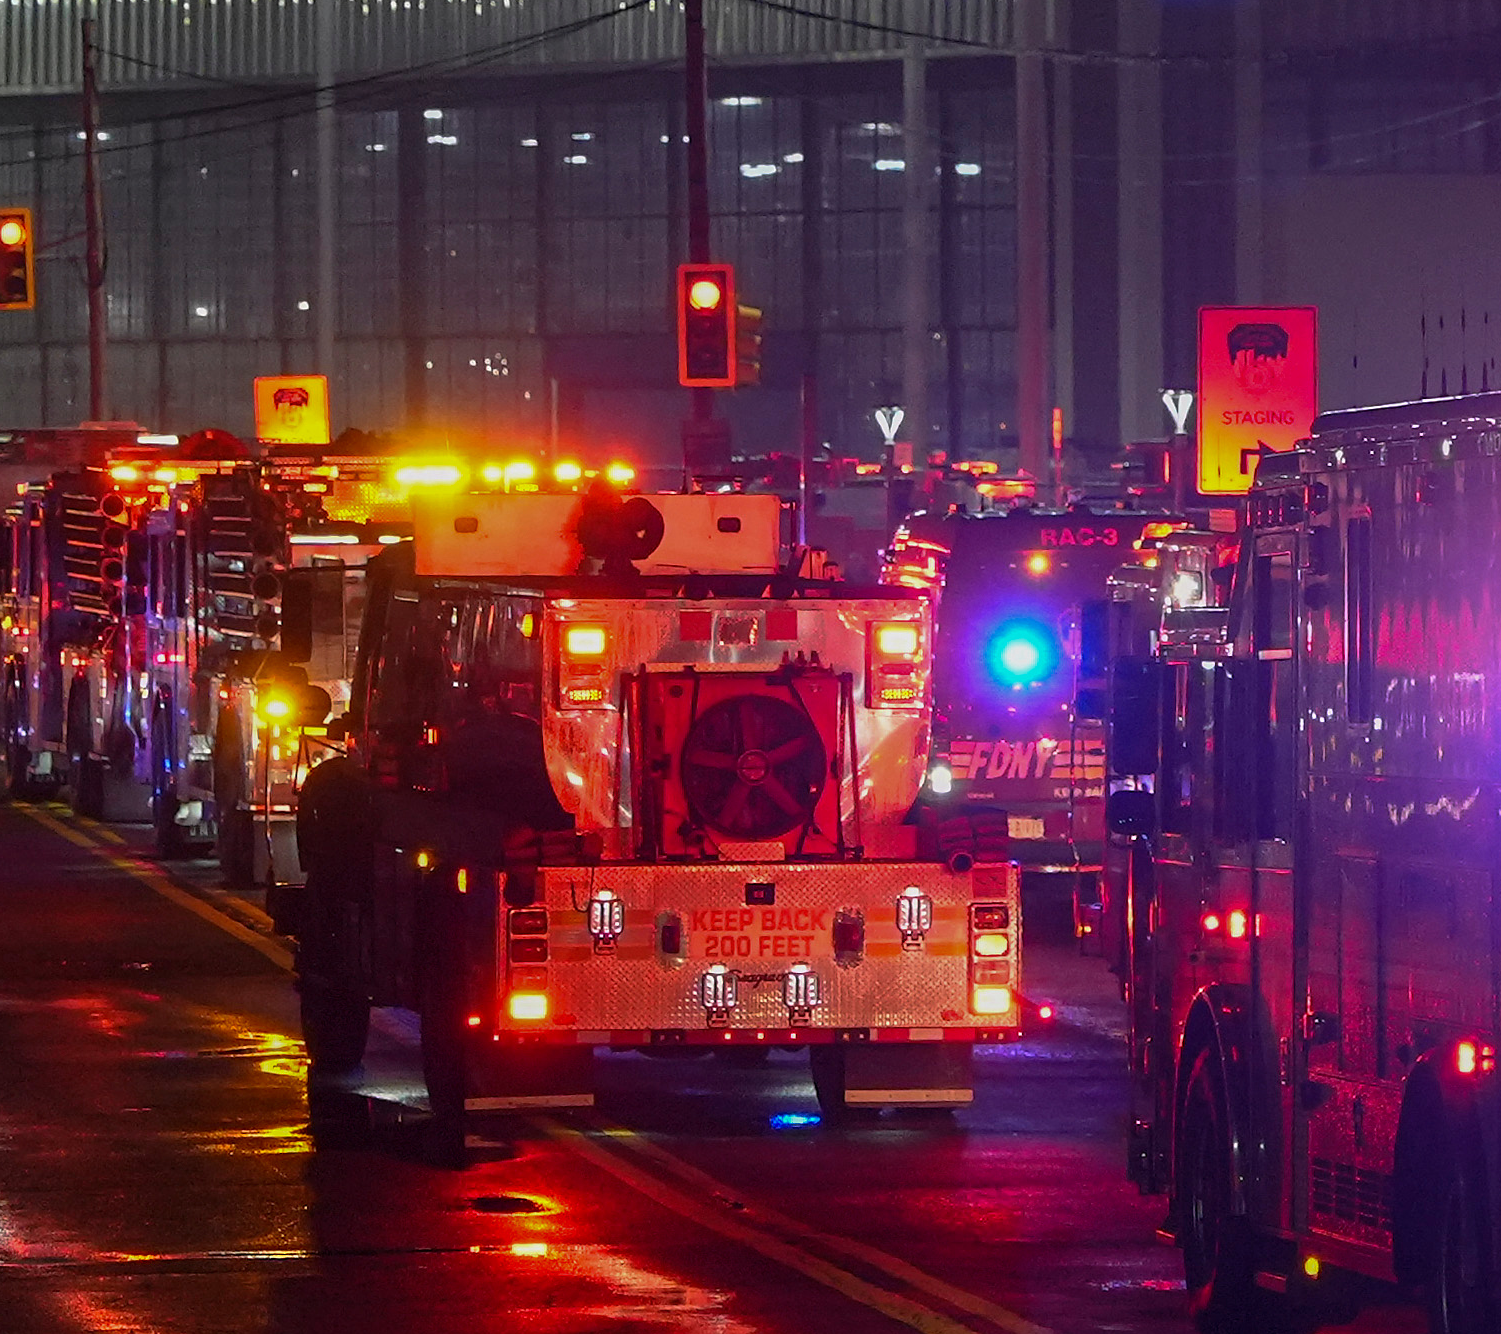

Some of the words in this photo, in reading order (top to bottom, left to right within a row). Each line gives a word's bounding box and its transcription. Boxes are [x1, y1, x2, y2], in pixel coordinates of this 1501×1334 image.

[1221, 410, 1295, 426] STAGING
[1040, 527, 1119, 547] RAC-3
[967, 740, 1056, 780] FDNY
[693, 910, 753, 931] KEEP
[761, 909, 827, 932] BACK
[705, 935, 751, 957] 200
[759, 935, 815, 957] FEET
